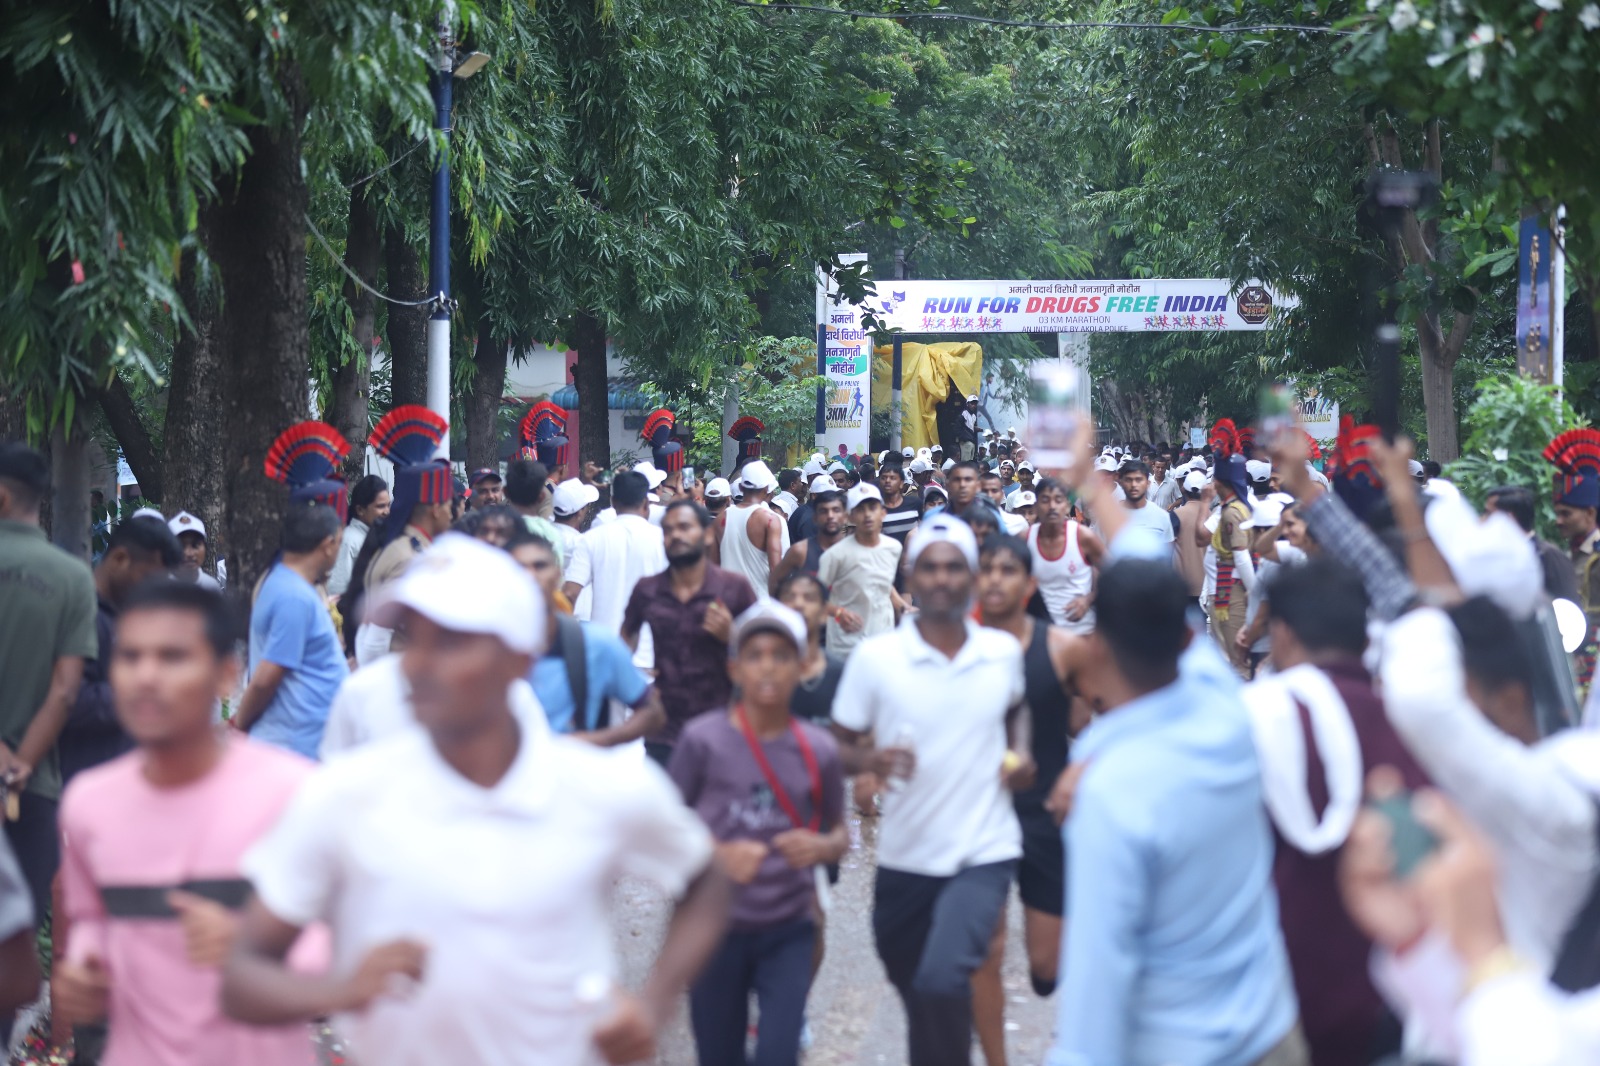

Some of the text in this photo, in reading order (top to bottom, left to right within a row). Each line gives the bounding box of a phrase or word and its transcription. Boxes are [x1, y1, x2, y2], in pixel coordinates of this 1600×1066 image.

[1009, 284, 1140, 296] अमली पदार्थ विरोधी जनजागृती मोहीम
[922, 295, 1228, 314] RUN FOR DRUGS FREE INDIA
[830, 312, 854, 324] अमली
[1038, 316, 1111, 324] 03 KM MARATHON
[825, 327, 865, 341] दार्थ विरोधी
[830, 361, 855, 374] मोहीम
[826, 407, 848, 421] 3KM
